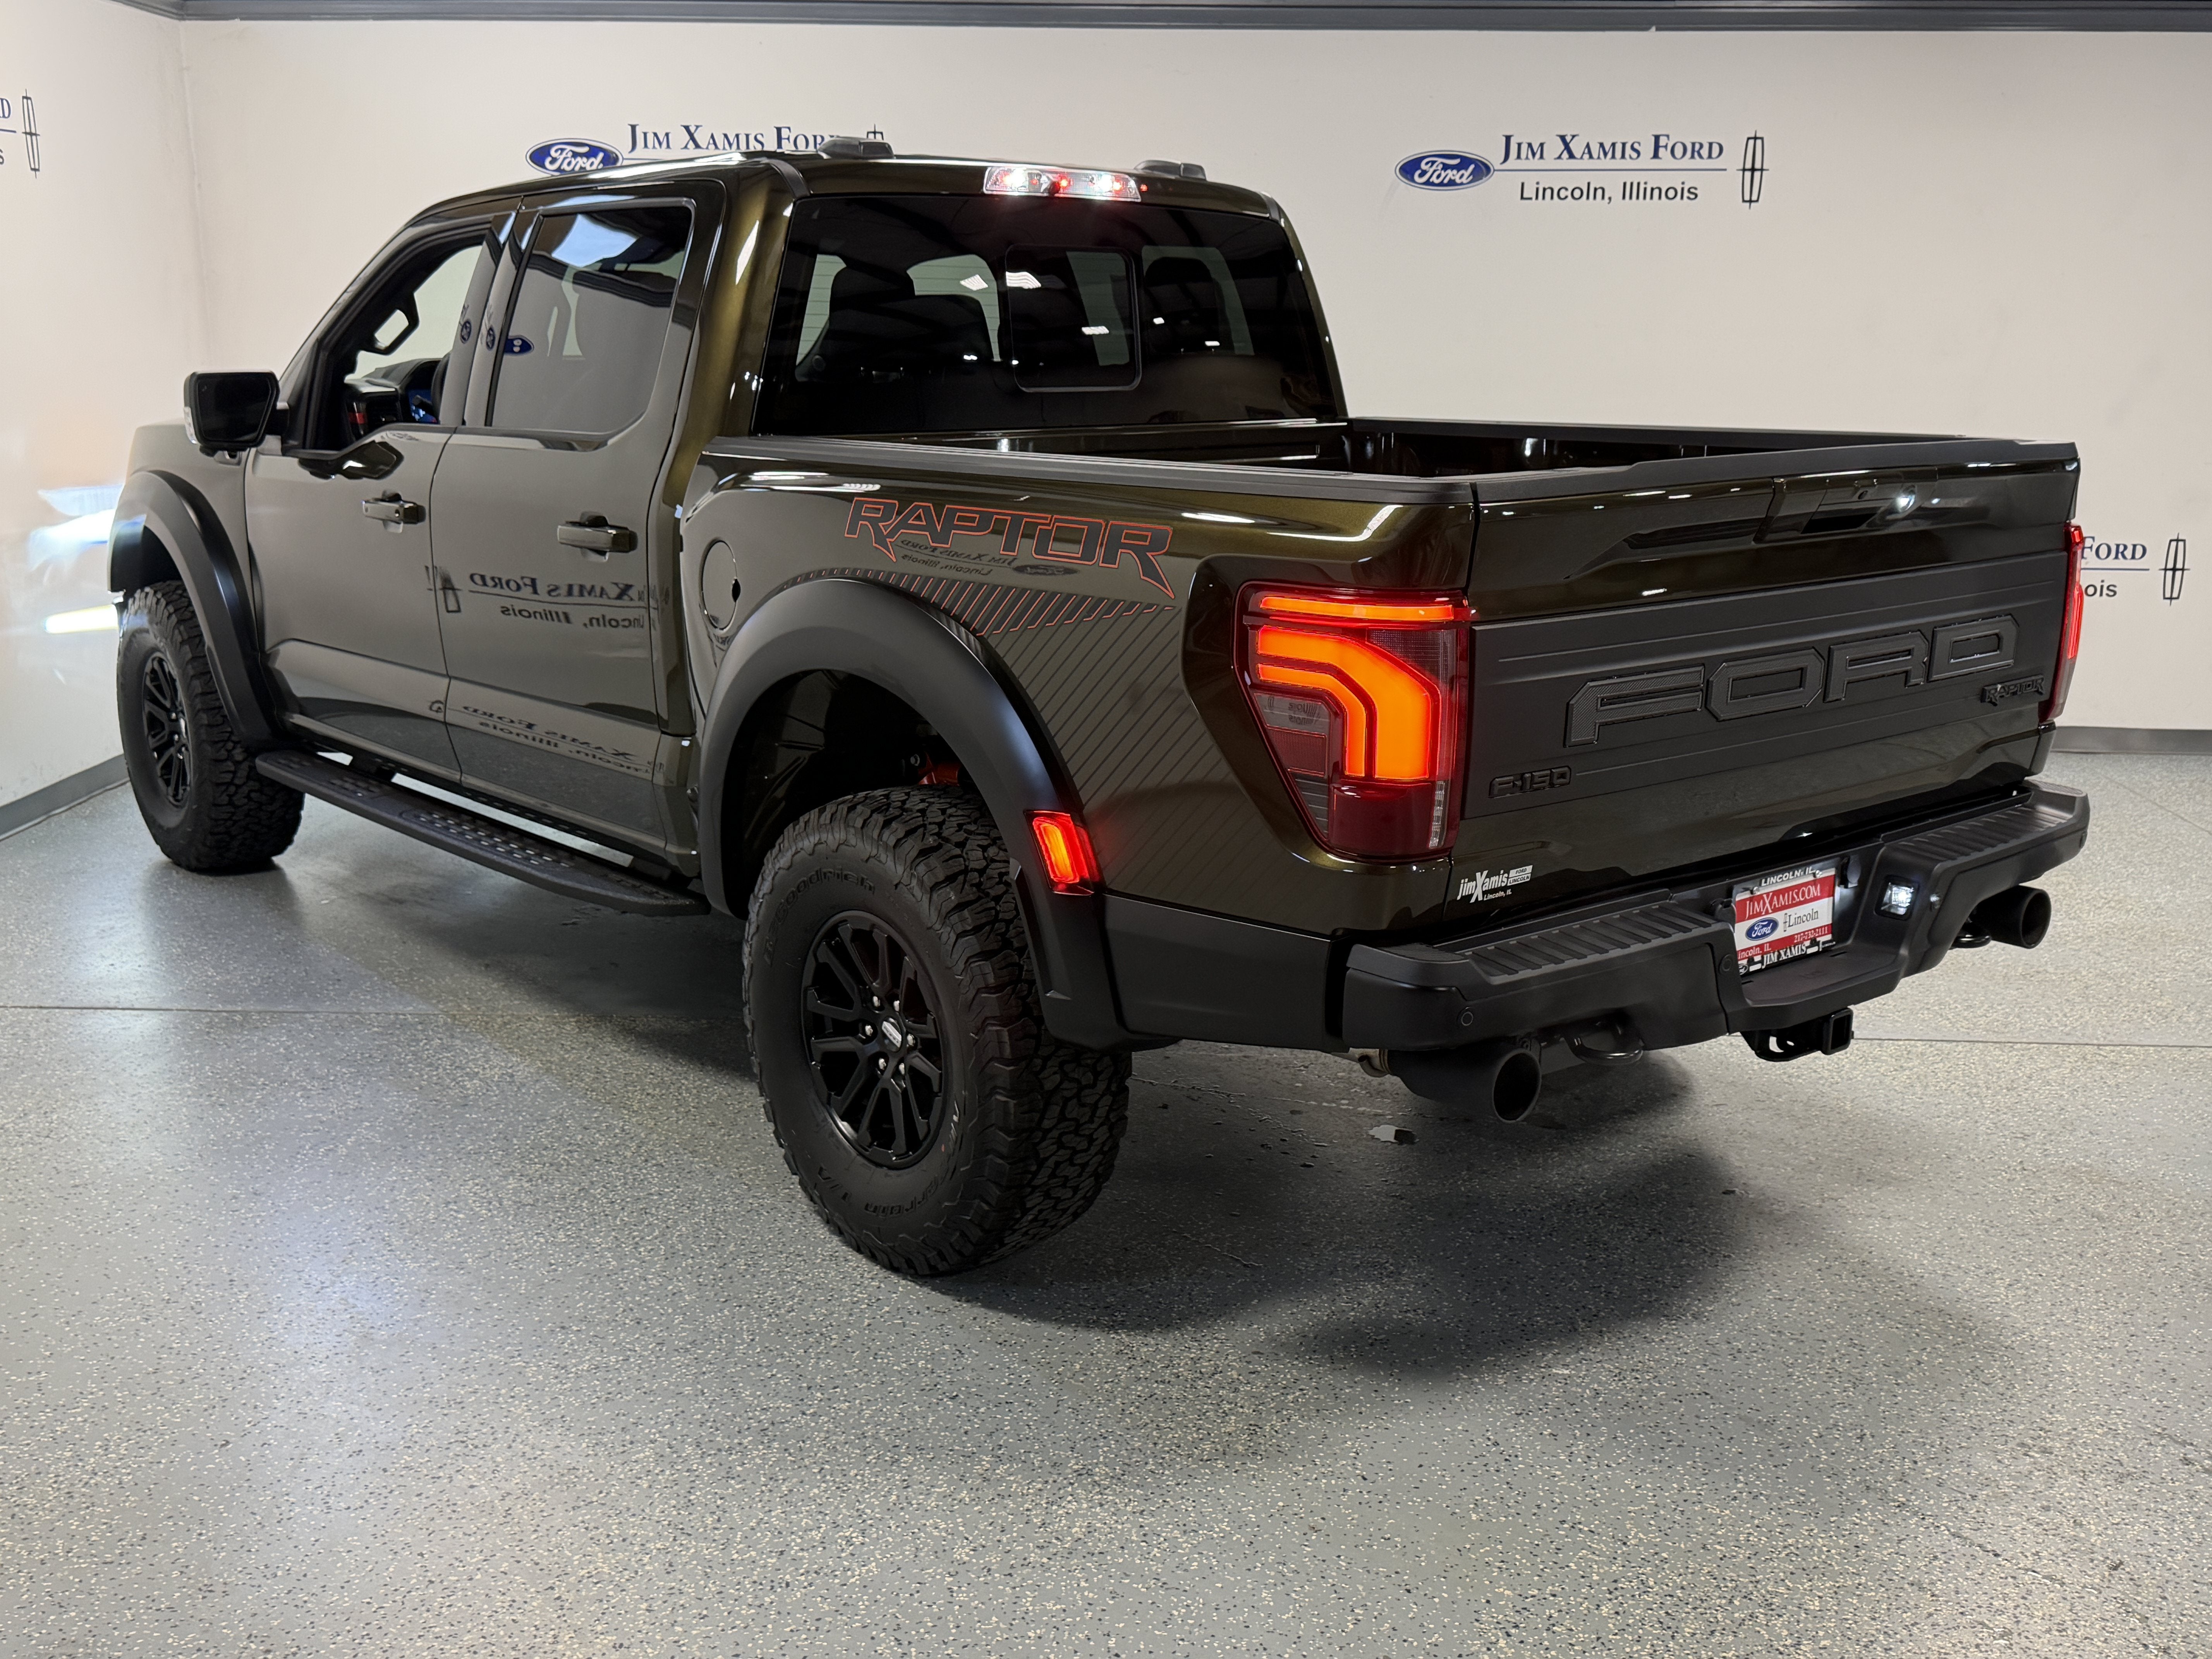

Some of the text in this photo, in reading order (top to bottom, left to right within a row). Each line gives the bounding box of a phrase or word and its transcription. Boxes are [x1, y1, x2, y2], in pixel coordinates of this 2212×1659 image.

[627, 124, 840, 154] JIM XAMIS FOR
[1499, 134, 1724, 165] JIM XAMIS FORD
[544, 144, 604, 171] Ford
[1413, 157, 1475, 185] Ford
[1520, 181, 1698, 204] Lincoln, Illinois
[845, 497, 1175, 599] RAPTOR
[2081, 536, 2147, 560] FORD
[1564, 614, 2019, 747] FORD
[1981, 674, 2045, 706] RAPTOR
[1489, 766, 1571, 798] F-150
[1509, 874, 1530, 884] LINCOLN
[1484, 891, 1505, 901] Lincoln,
[1752, 921, 1773, 938] Ford
[1787, 908, 1819, 927] Lincoln
[1764, 943, 1772, 952] IL
[1794, 926, 1828, 943] 217-732-2111
[1762, 943, 1807, 969] JIM XAMIS
